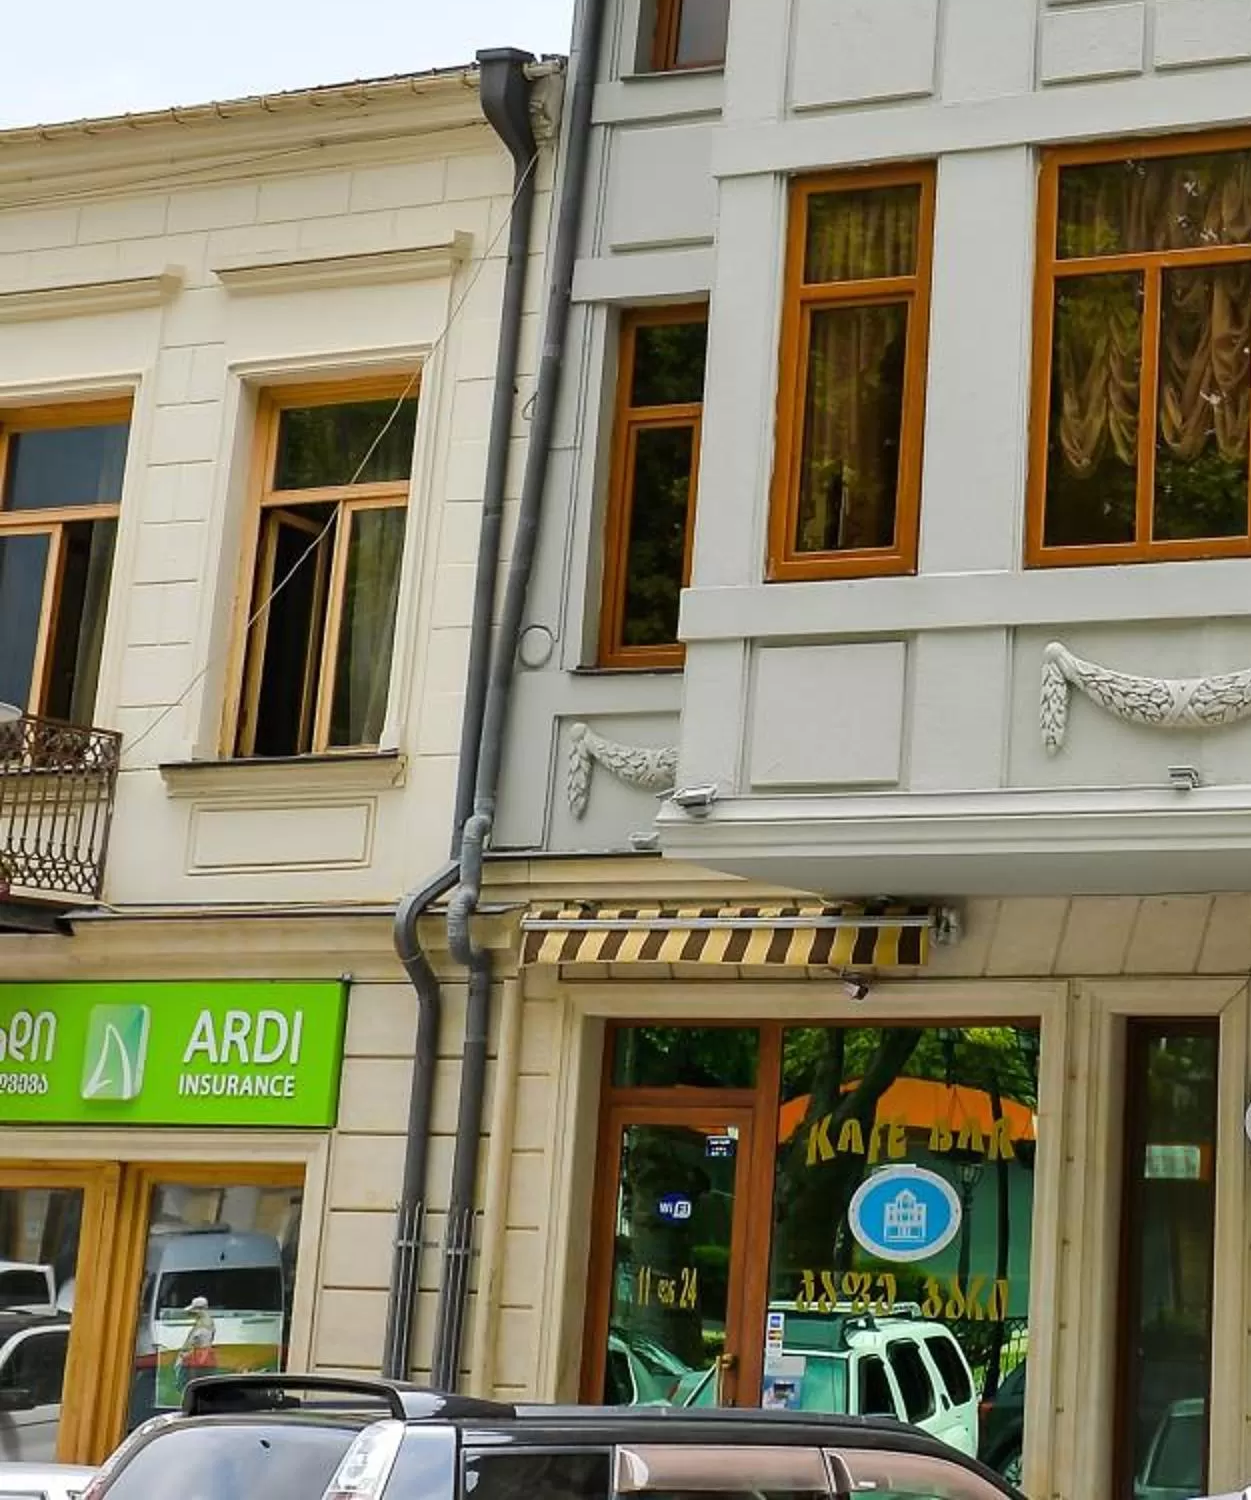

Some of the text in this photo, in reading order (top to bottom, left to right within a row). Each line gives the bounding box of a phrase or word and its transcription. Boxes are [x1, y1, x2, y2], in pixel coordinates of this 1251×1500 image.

[183, 1009, 303, 1065] ARDI
[179, 1074, 295, 1098] INSURANCE
[806, 1113, 1015, 1164] KAFE BAR
[679, 1267, 697, 1309] 24
